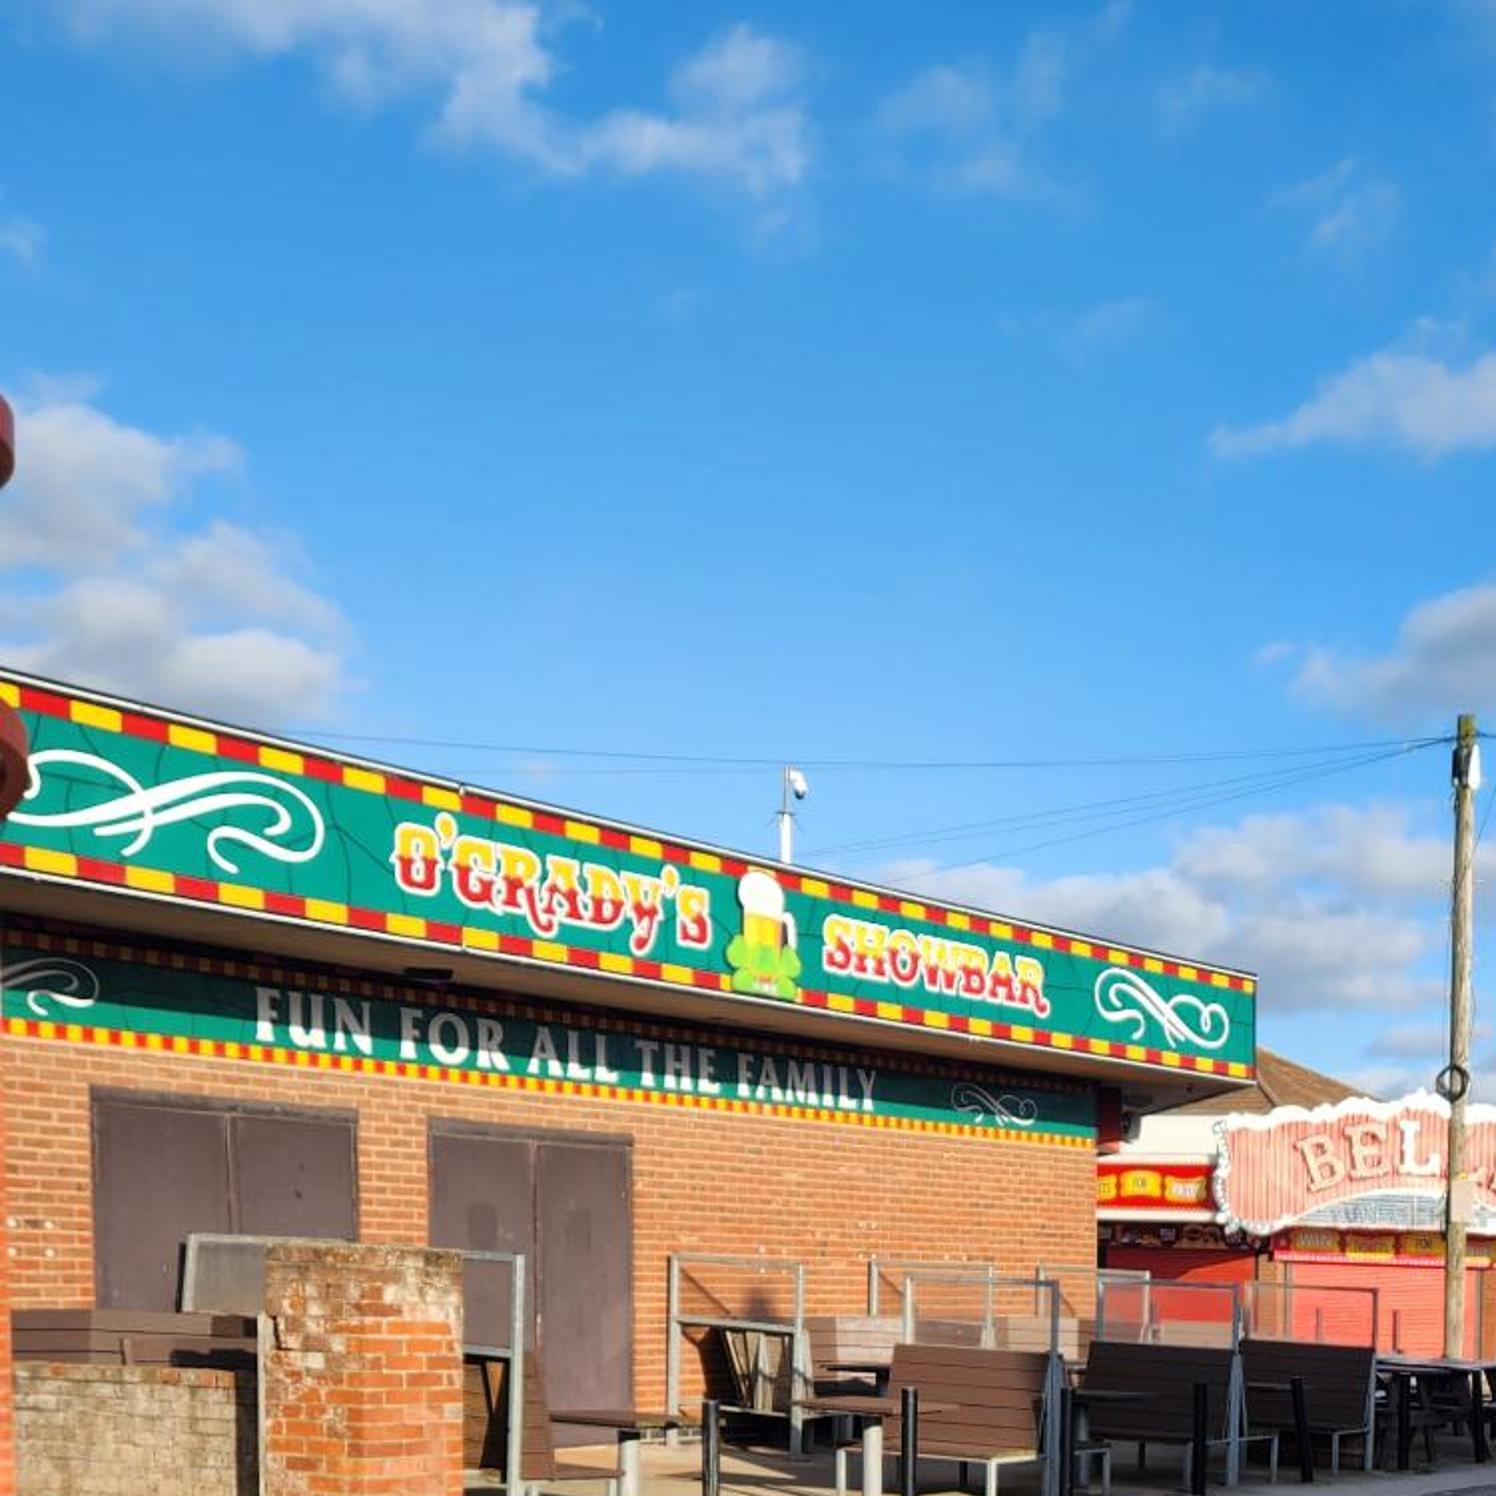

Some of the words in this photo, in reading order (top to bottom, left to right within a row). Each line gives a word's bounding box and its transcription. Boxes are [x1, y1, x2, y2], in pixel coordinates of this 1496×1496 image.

[392, 812, 713, 957] O'GRADY'S
[821, 912, 1051, 1018] SHOWBAR
[254, 986, 374, 1056] FUN
[400, 1005, 511, 1074] FOR
[527, 1024, 620, 1084] ALL
[634, 1038, 721, 1095] THE
[736, 1051, 877, 1113] FAMILY
